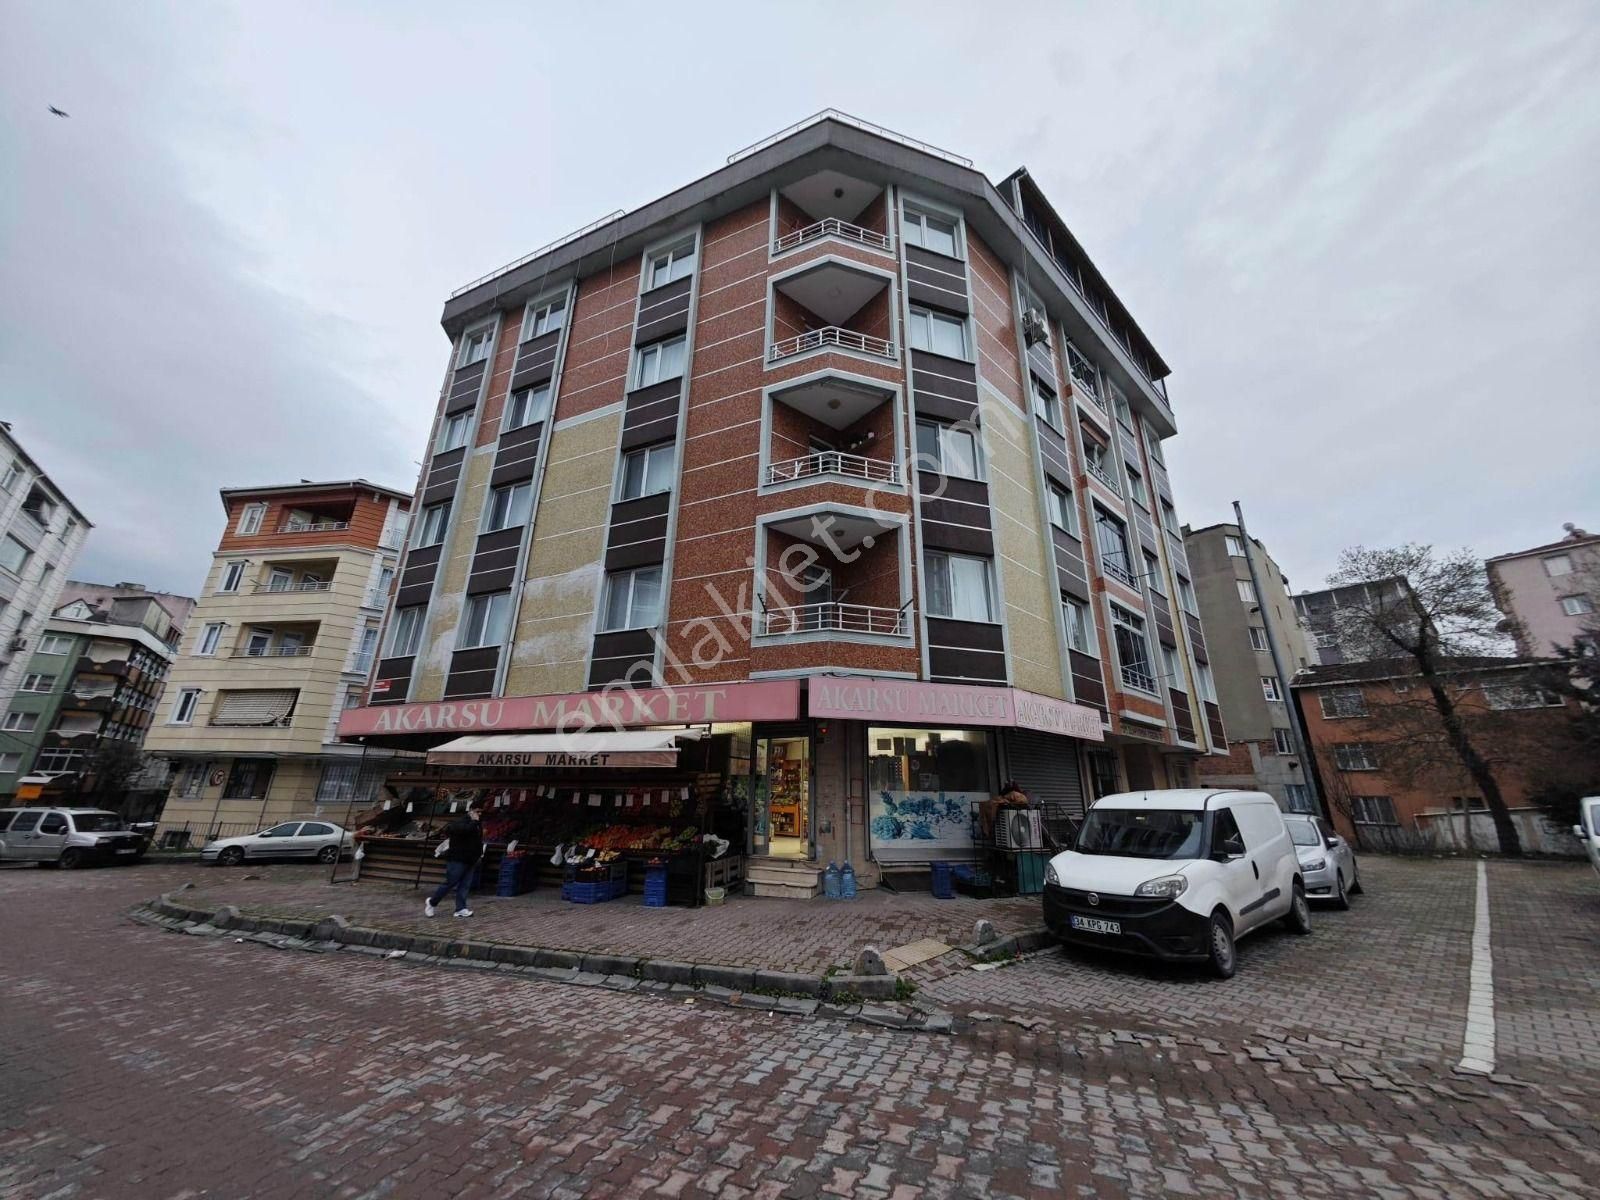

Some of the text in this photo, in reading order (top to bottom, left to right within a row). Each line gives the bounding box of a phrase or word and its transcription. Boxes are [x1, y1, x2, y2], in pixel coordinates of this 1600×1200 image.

[374, 690, 726, 731] AKARSU MARKET
[817, 686, 1008, 718] AKARSU MARKET
[477, 754, 610, 765] AKARSU MARKET
[1074, 917, 1120, 933] 34 KPG 743
